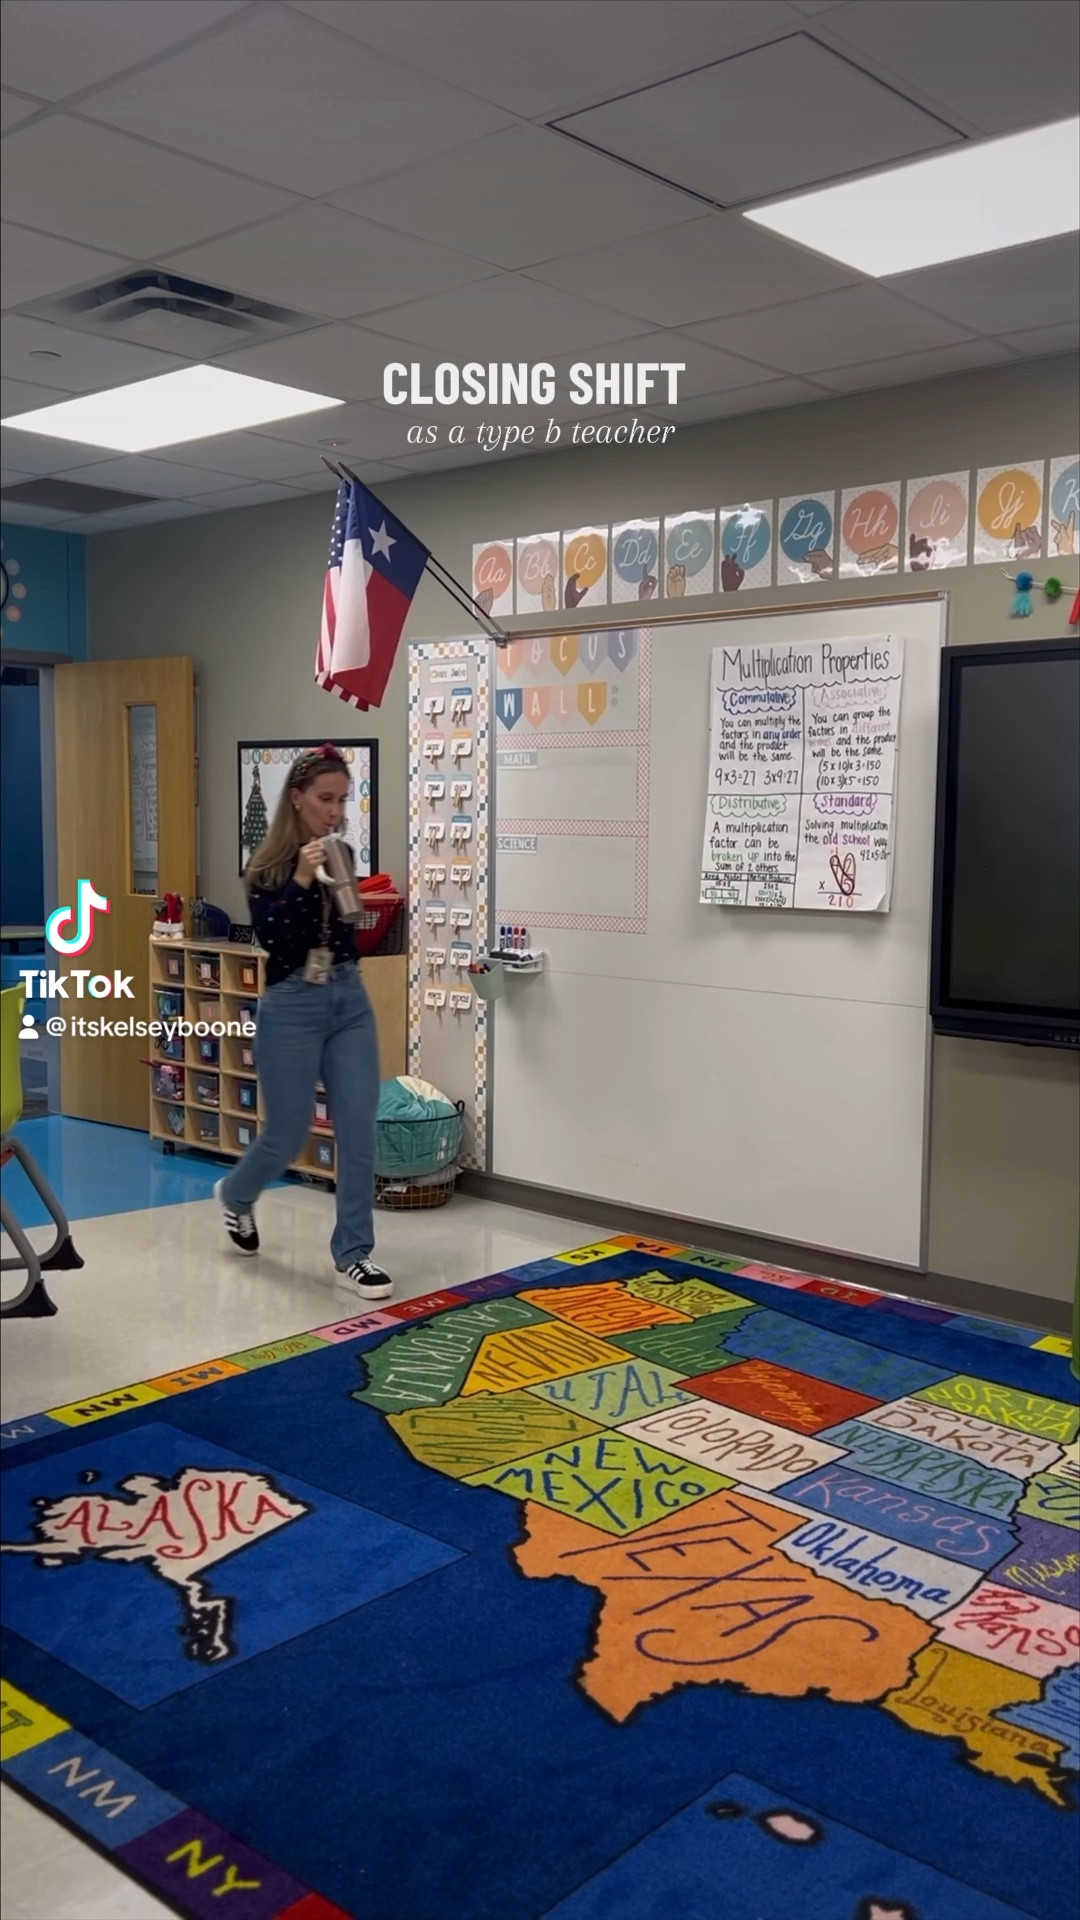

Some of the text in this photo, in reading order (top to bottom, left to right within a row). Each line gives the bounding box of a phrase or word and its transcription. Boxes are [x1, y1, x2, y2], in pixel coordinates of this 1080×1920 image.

[920, 494, 950, 528] Ii
[990, 481, 1024, 530] Jj
[784, 509, 826, 550] Gg
[850, 506, 890, 539] Hh
[574, 542, 597, 572] Cc
[619, 536, 651, 568] Dd
[675, 530, 702, 560] Ee
[479, 557, 506, 584] Aa
[522, 555, 550, 579] Bb
[722, 643, 890, 689] Multiplication Properties
[820, 684, 882, 702] Associative
[720, 714, 801, 730] You can multiply the
[808, 722, 890, 737] factors in different
[812, 707, 890, 725] You can group the
[720, 739, 788, 752] and the product
[721, 727, 802, 743] factors in any order
[836, 735, 850, 746] and
[856, 734, 869, 745] the
[874, 733, 896, 748] product
[503, 753, 530, 765] MATH
[719, 750, 735, 761] will
[739, 750, 749, 761] be
[753, 749, 768, 762] the
[812, 749, 825, 758] will
[831, 747, 841, 757] be
[845, 746, 860, 757] the
[719, 795, 781, 810] Distributive
[822, 794, 873, 807] Standard
[713, 821, 788, 836] A multiplication
[805, 820, 888, 833] Solving multiplication
[805, 834, 819, 844] the
[823, 833, 838, 845] old
[497, 837, 536, 850] SCIENCE
[710, 837, 779, 849] factor can be
[712, 851, 796, 865] broken up into the
[735, 862, 744, 872] of
[748, 863, 753, 872] 2
[755, 863, 778, 873] others
[828, 894, 853, 908] 210
[570, 1249, 605, 1261] KS
[690, 1255, 731, 1269] IN
[402, 1297, 445, 1314] ME
[530, 1286, 680, 1335] OREGON
[333, 1317, 383, 1336] MD
[371, 1301, 534, 1403] CALIFORNIA
[472, 1323, 627, 1388] NEVADA
[625, 1319, 729, 1370] Idaho
[170, 1365, 224, 1386] MI
[73, 1391, 140, 1418] MN
[926, 1382, 1075, 1420] NORTH
[409, 1397, 578, 1465] ARIZONA
[895, 1399, 1050, 1452] SOUTH
[949, 1401, 1073, 1440] DAKOTA
[870, 1409, 1037, 1469] DAKOTA
[545, 1437, 689, 1477] NEW
[829, 1424, 1017, 1512] NEBRASKA
[494, 1467, 706, 1530] MEXICO
[54, 1477, 293, 1561] ALASKA
[794, 1471, 1001, 1557] Kansas
[790, 1522, 951, 1605] Oklahoma
[558, 1499, 880, 1667] TEXAS
[884, 1646, 1057, 1757] Louisiana
[47, 1756, 138, 1820] NM
[165, 1838, 261, 1897] NY
